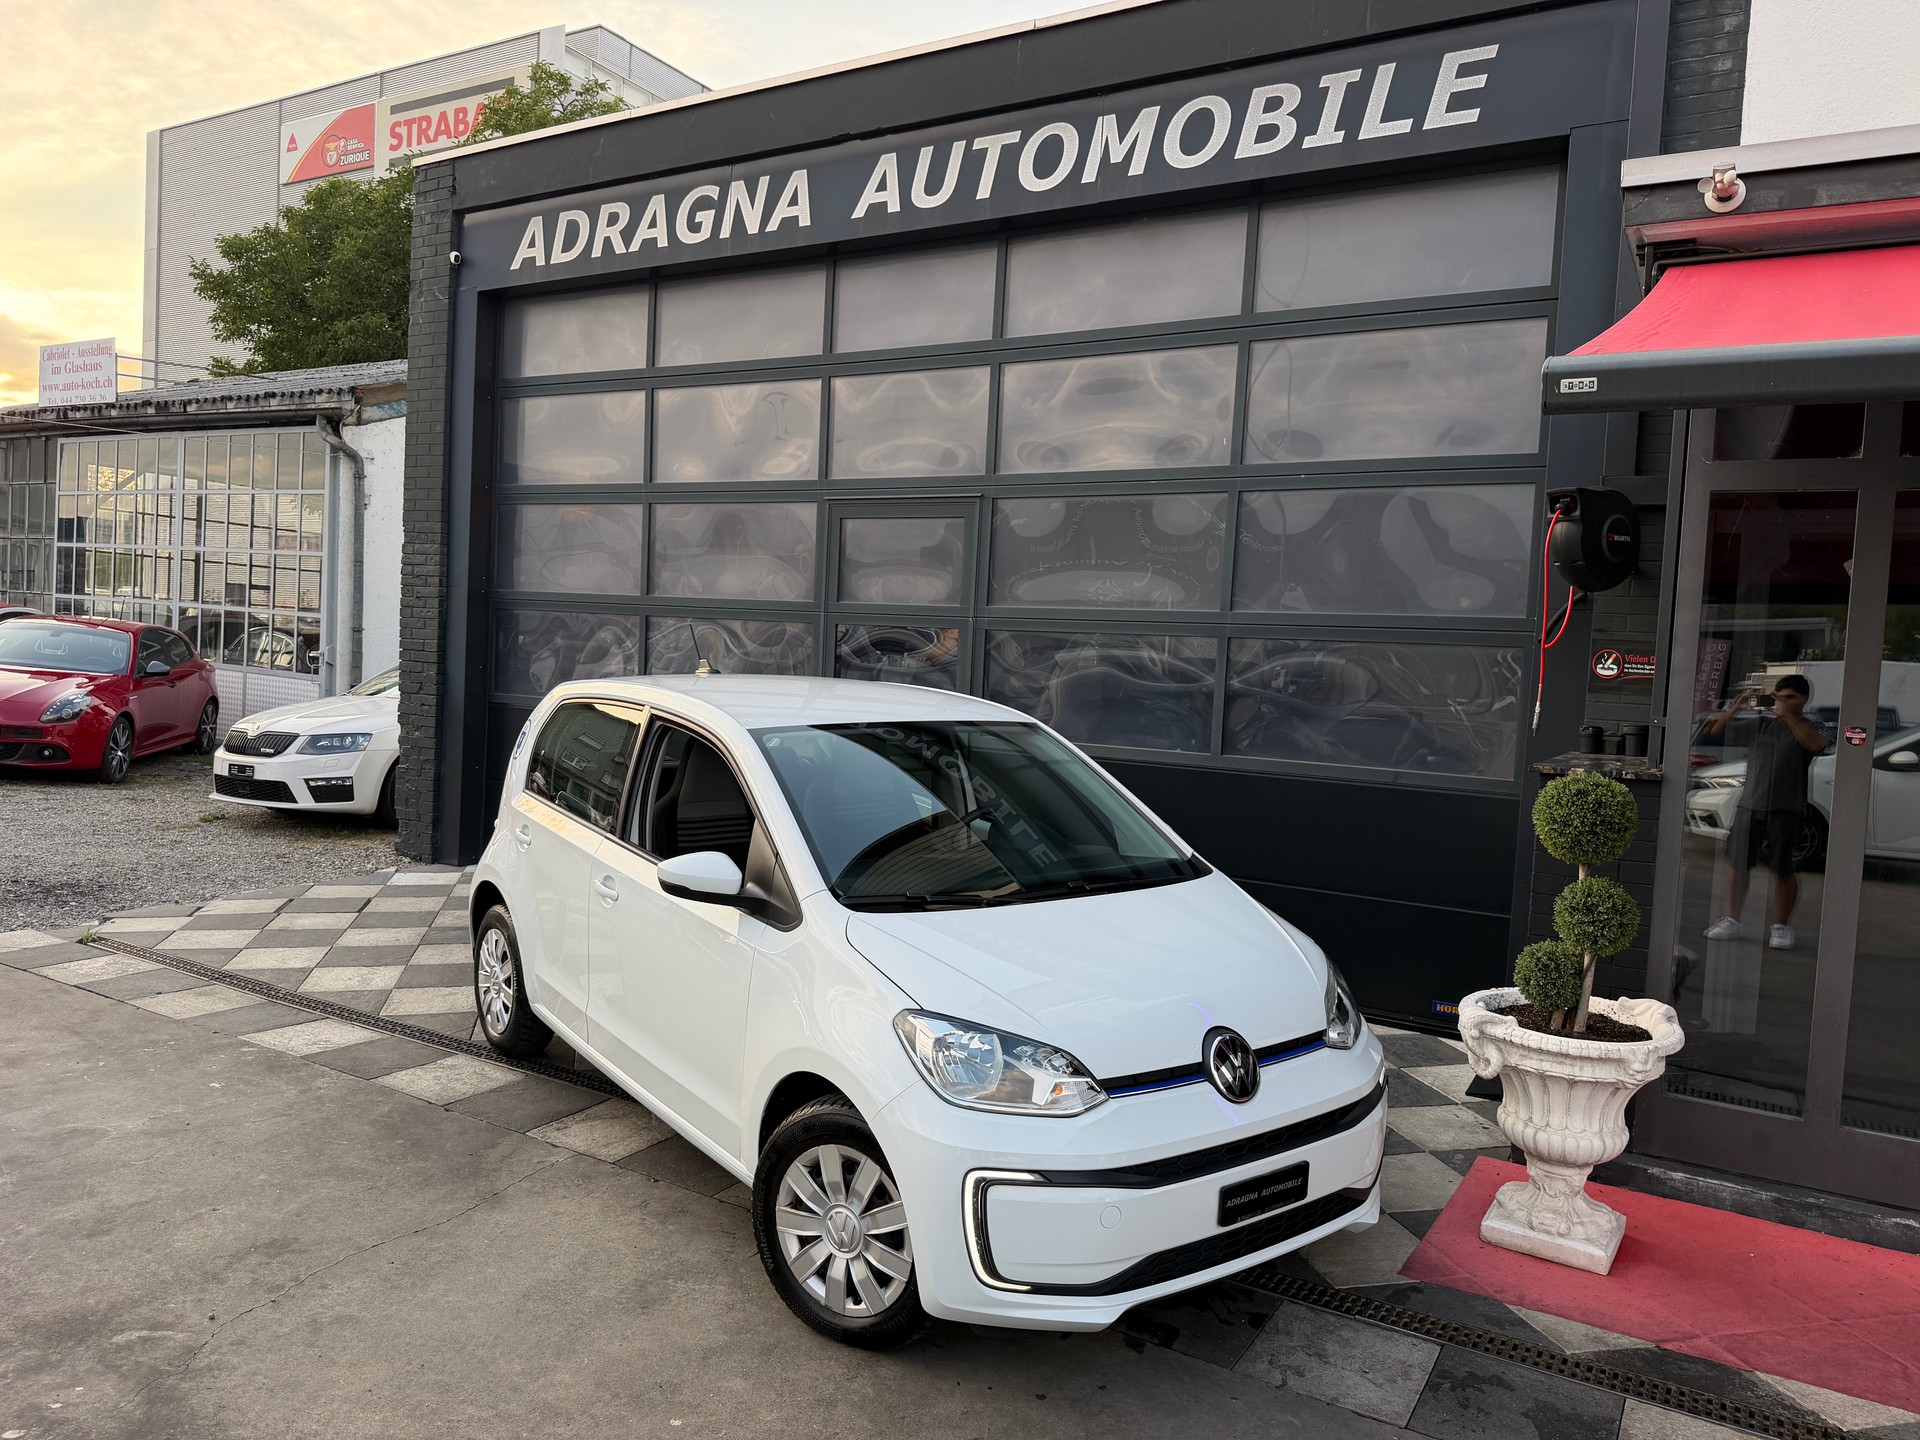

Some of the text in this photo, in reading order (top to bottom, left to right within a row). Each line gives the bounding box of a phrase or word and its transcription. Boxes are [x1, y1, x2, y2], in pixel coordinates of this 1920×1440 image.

[388, 101, 487, 152] STRABA
[340, 150, 370, 166] ZURIQUE
[510, 43, 1500, 271] ADRAGNA AUTOMOBILE
[77, 343, 113, 359] Ausstellung
[51, 360, 103, 375] im Glashaus
[42, 375, 113, 393] www.auto-koch.ch
[1624, 654, 1648, 663] Vielen
[1225, 1177, 1304, 1208] ADRAGNA AUTOMOBILE
